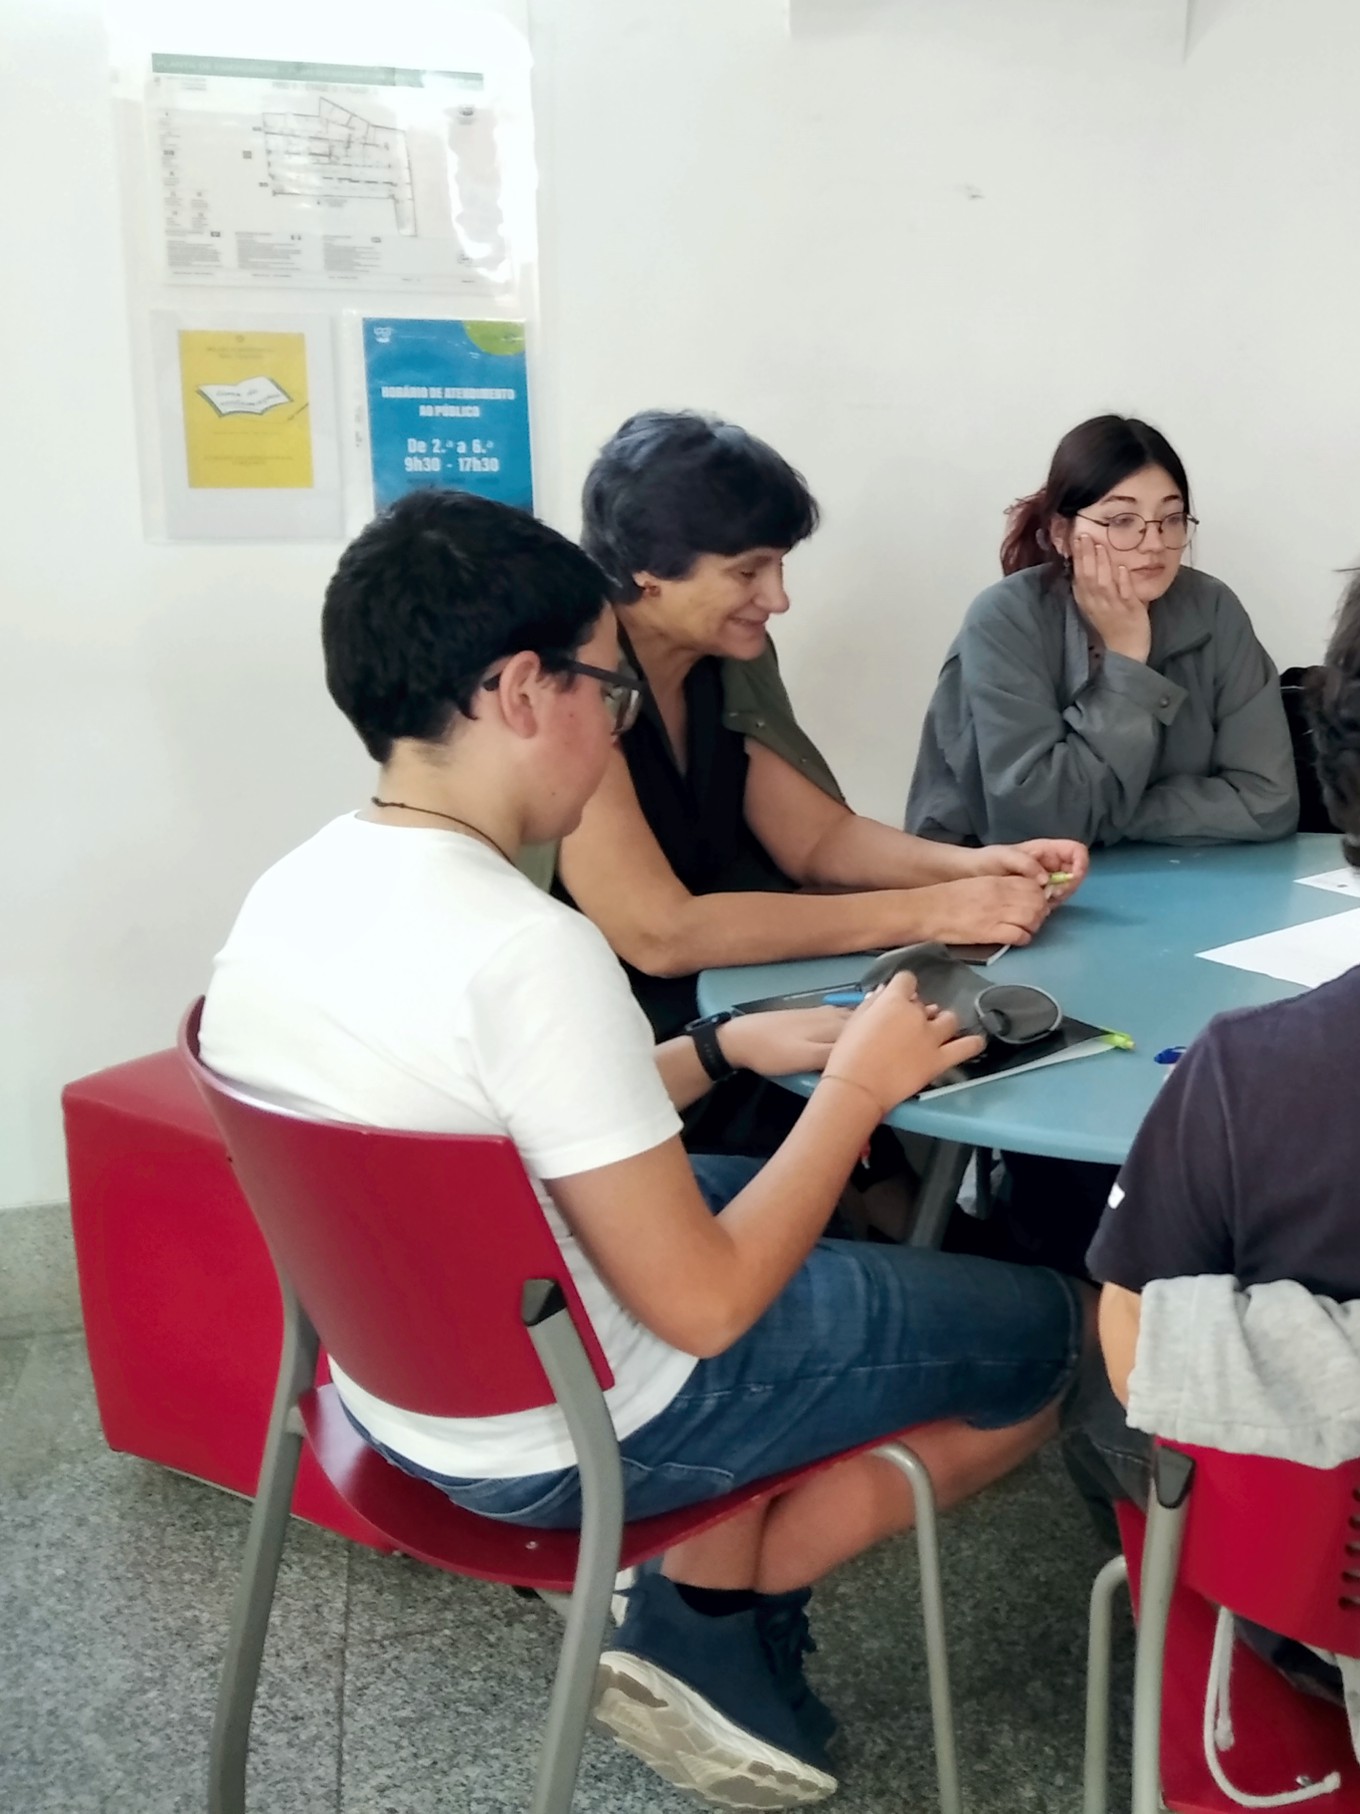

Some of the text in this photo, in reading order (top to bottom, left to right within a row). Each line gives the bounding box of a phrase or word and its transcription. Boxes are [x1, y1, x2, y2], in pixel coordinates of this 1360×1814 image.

[407, 438, 427, 453] De
[456, 441, 467, 453] a
[404, 457, 441, 472] 9h30
[458, 457, 499, 472] 17h30
